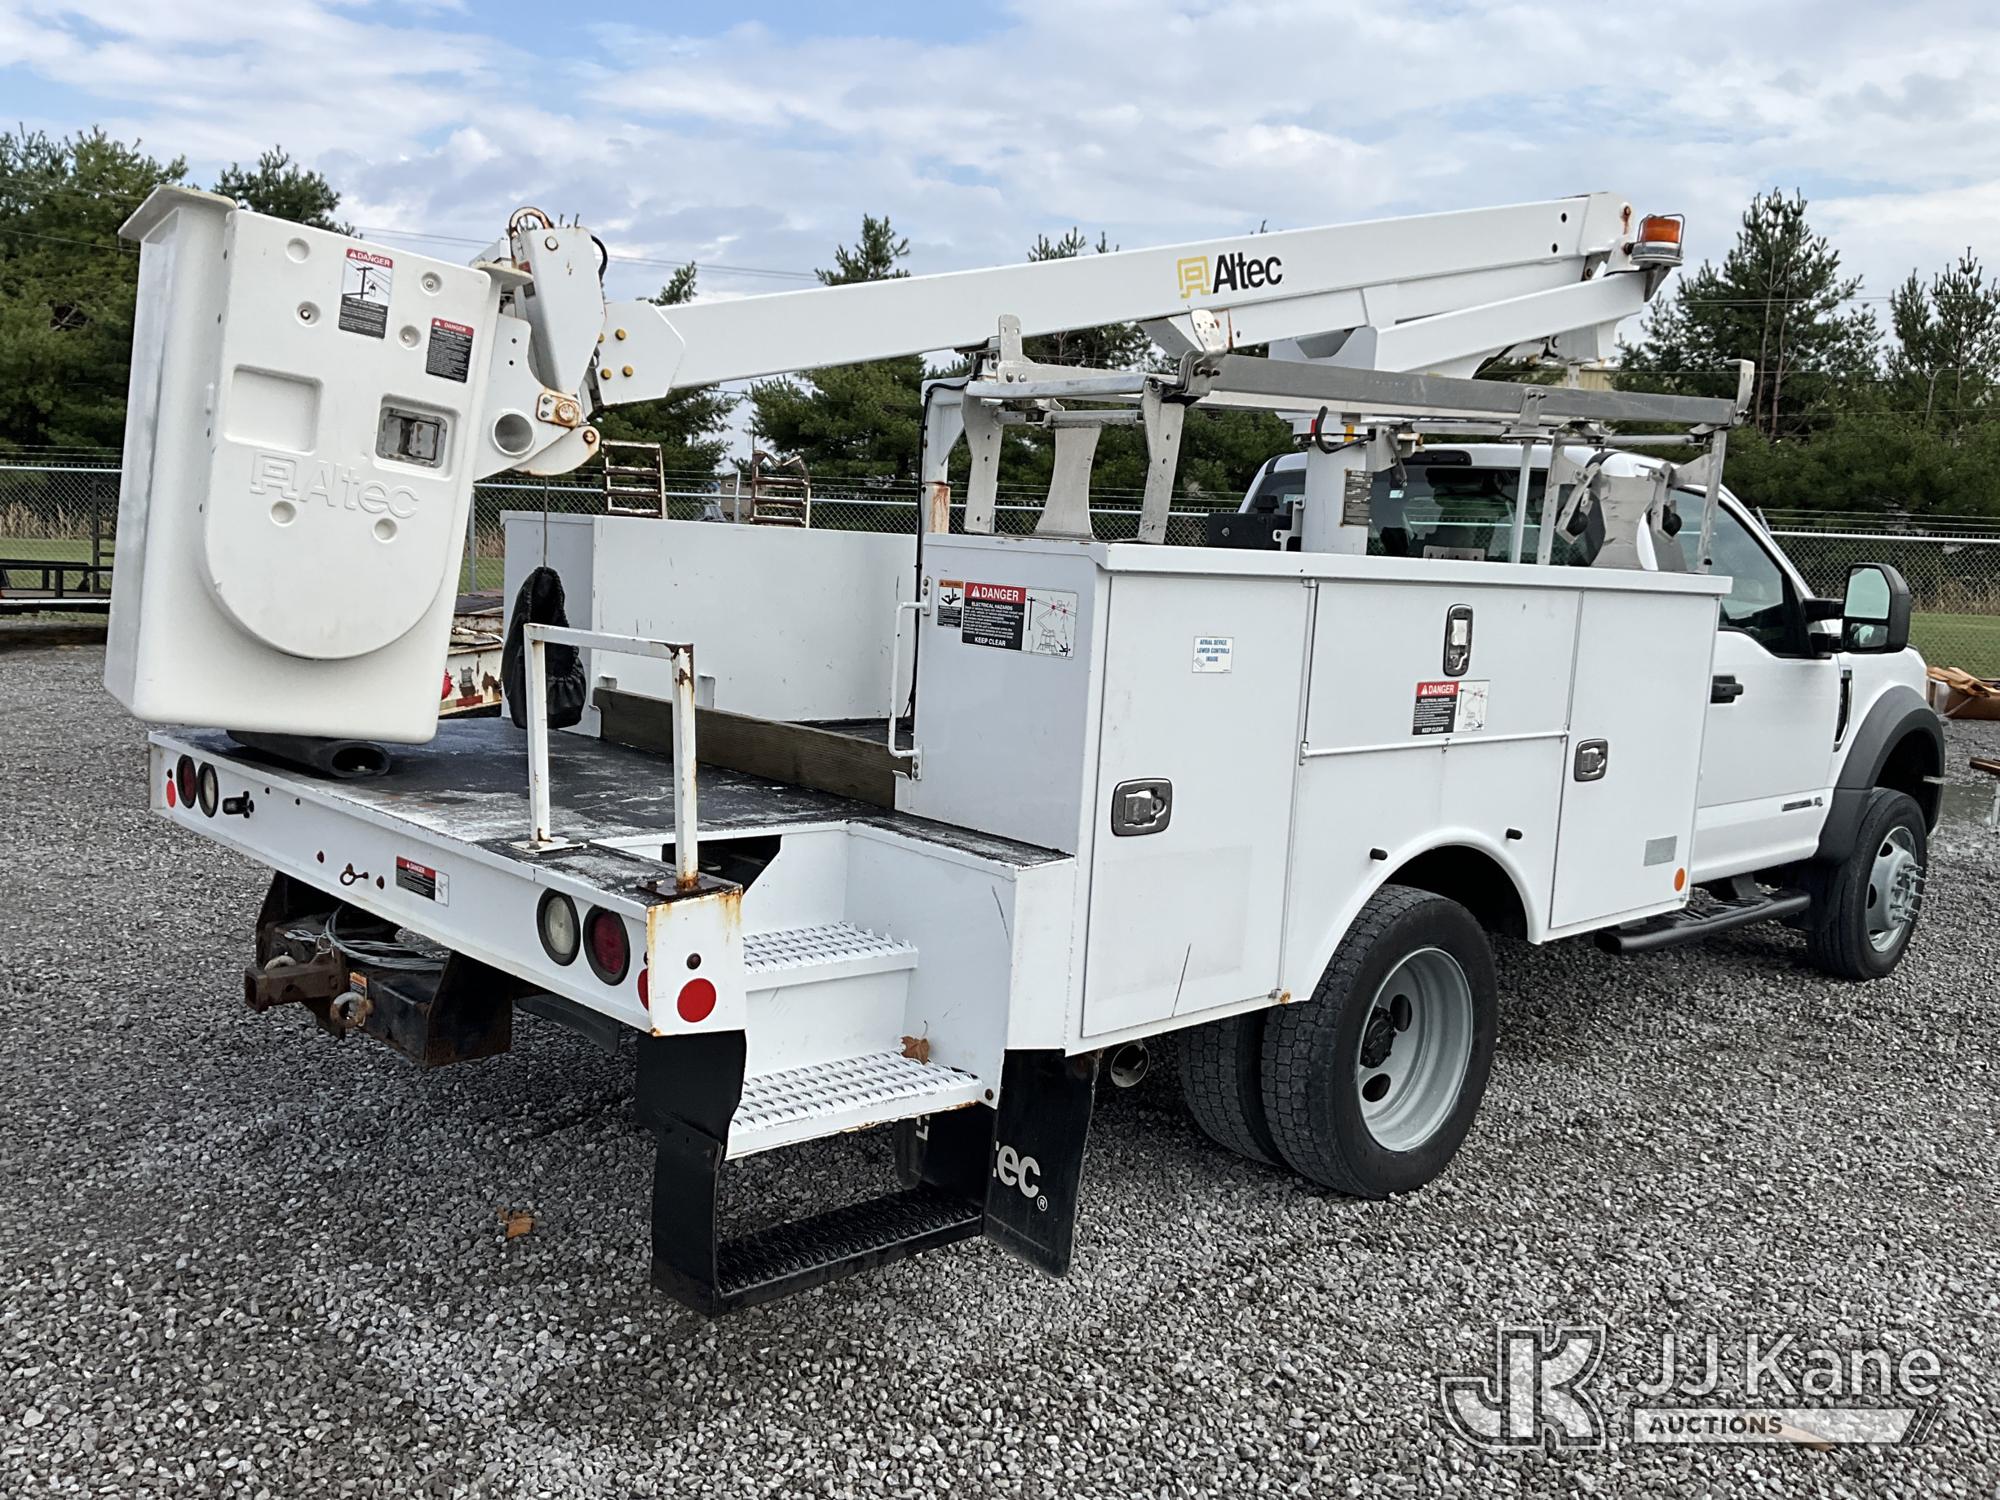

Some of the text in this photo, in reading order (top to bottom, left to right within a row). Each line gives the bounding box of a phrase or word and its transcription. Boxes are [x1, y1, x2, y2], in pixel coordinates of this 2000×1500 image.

[357, 252, 390, 267] DANGER
[1212, 252, 1283, 294] Altec
[298, 460, 419, 520] Altec
[981, 586, 1019, 602] DANGER
[974, 636, 1006, 647] KEEP CLEAR
[1428, 684, 1455, 695] DANGER
